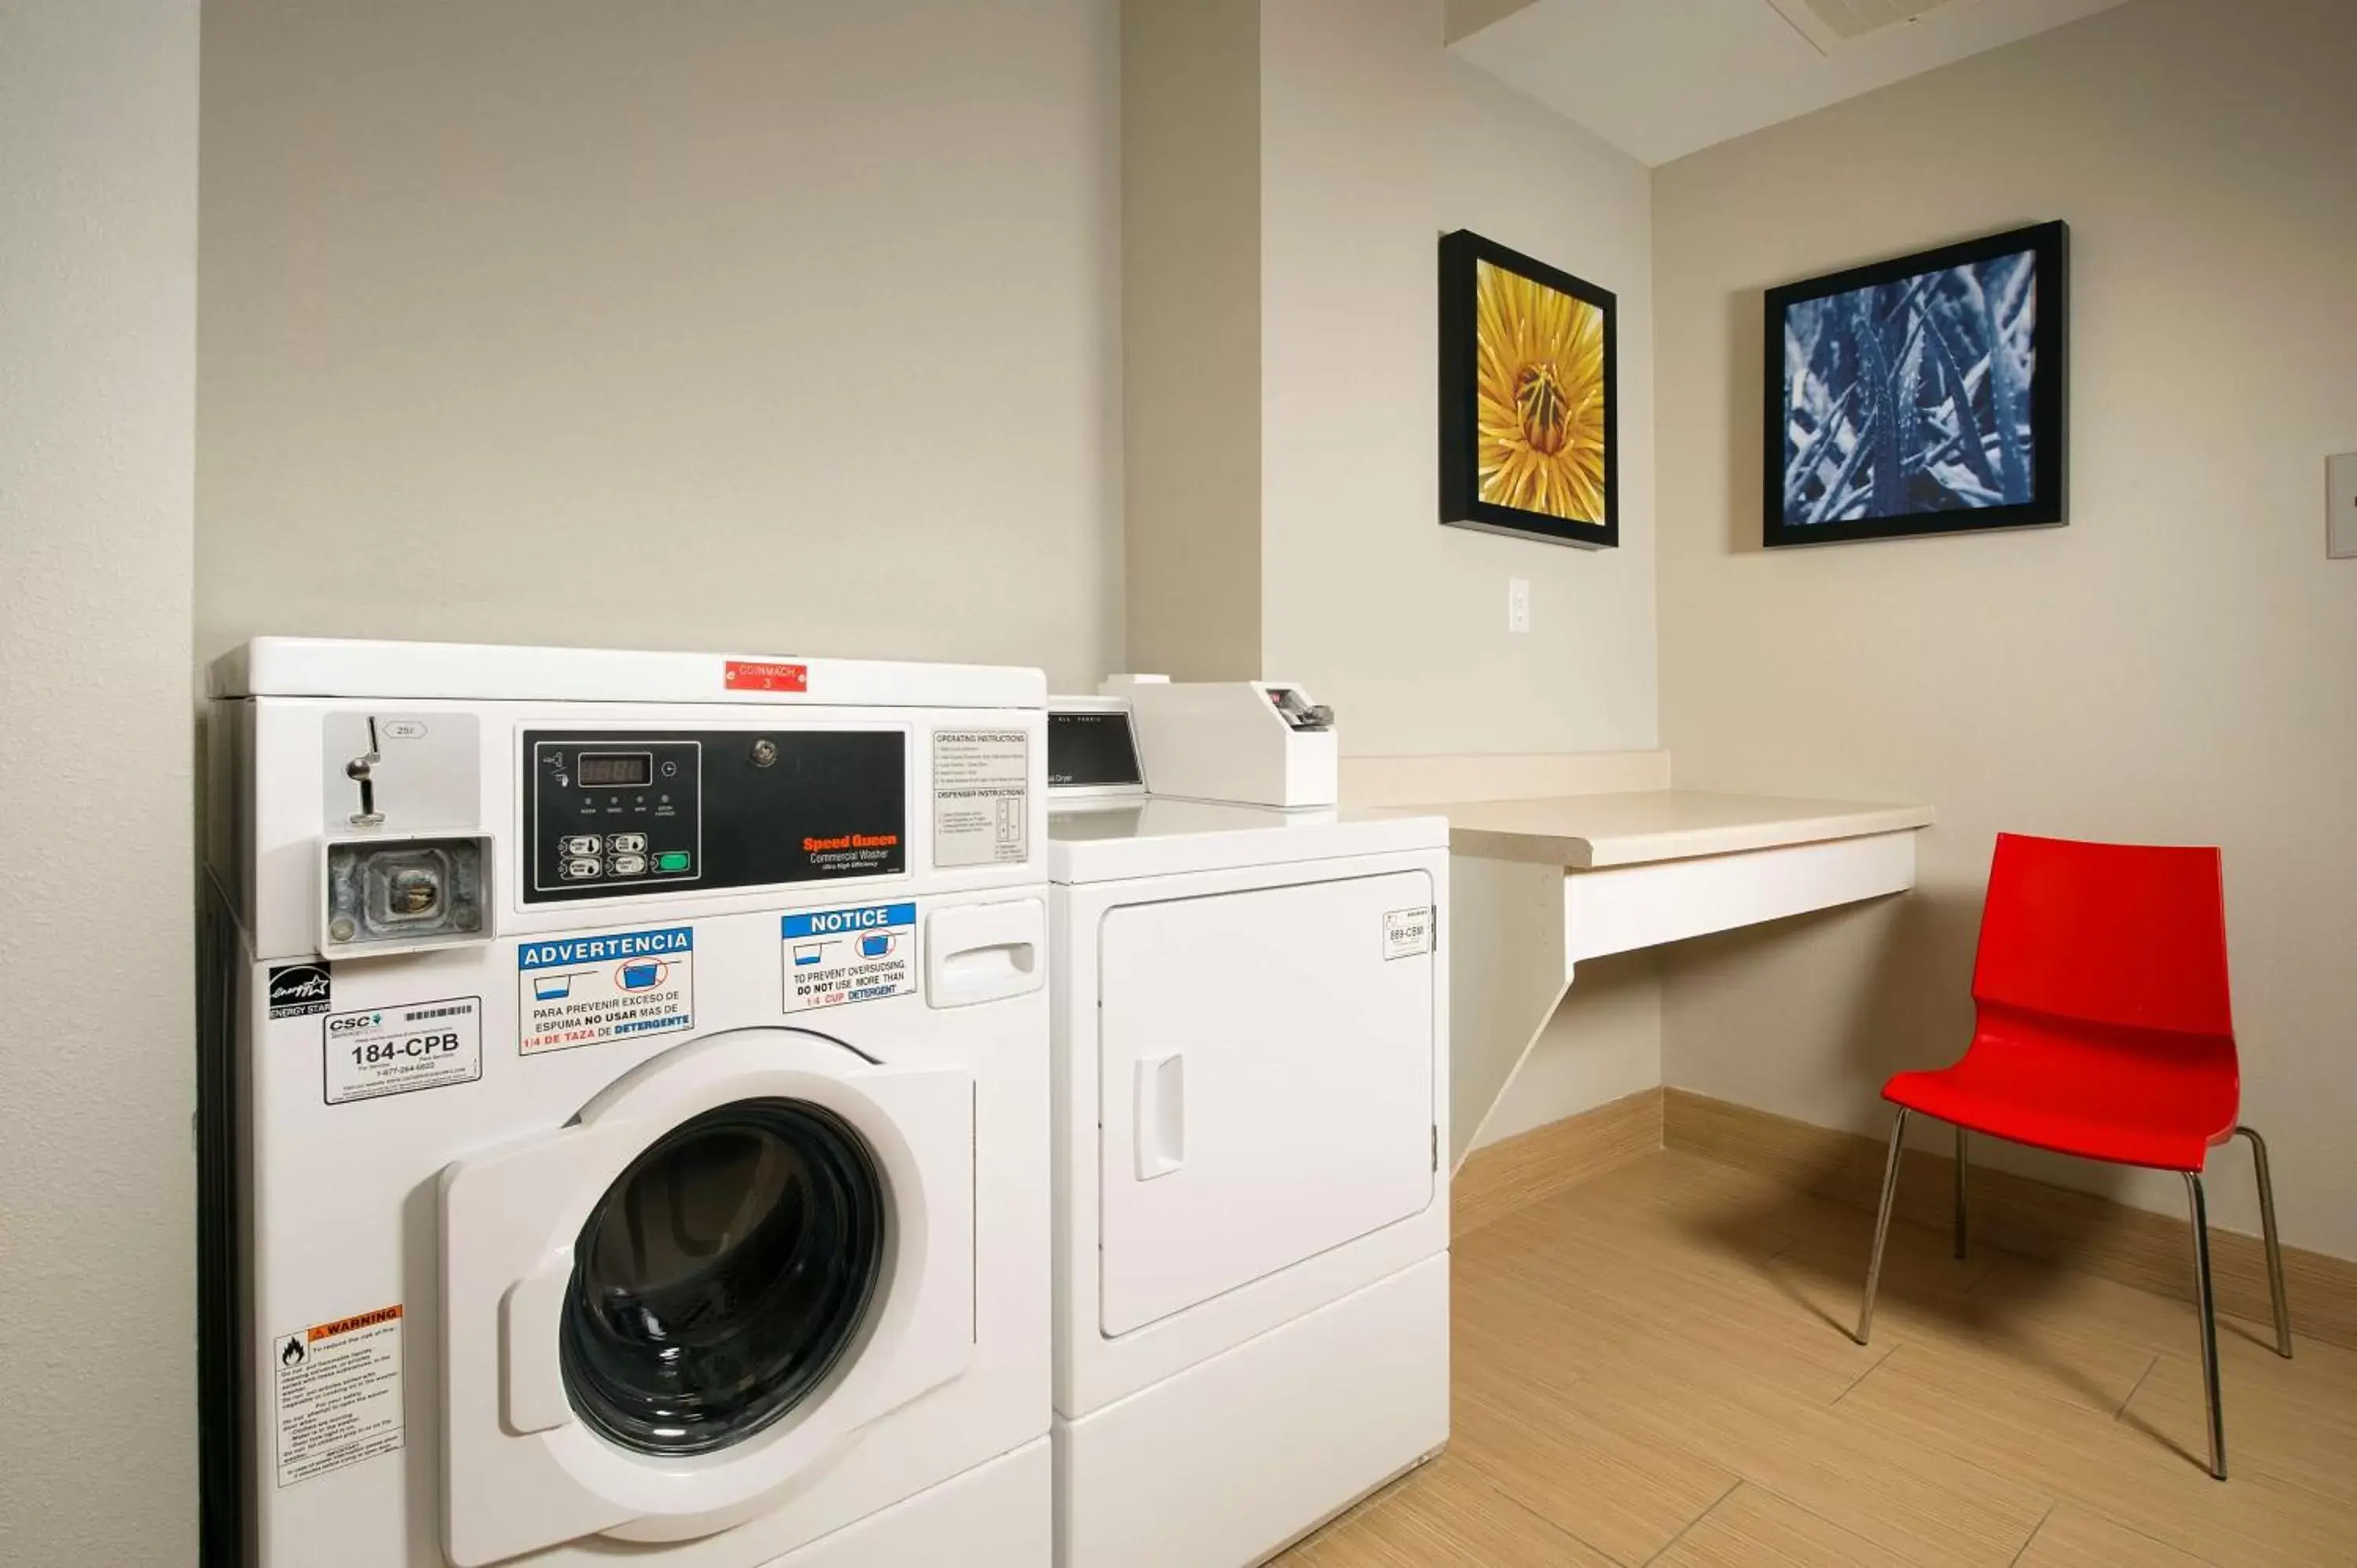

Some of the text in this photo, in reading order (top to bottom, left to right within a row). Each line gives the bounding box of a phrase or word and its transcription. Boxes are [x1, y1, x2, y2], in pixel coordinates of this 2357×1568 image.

[763, 678, 772, 688] 3
[977, 789, 1025, 797] INSTRUCTIONS
[803, 833, 897, 852] Speed Queen
[810, 849, 889, 863] Commercial Washer
[811, 908, 889, 932] NOTICE
[524, 932, 688, 965] ADVERTENCIA
[794, 973, 806, 984] TO
[807, 967, 846, 983] PREVENT
[797, 972, 904, 995] DO NOT USE MORE THAN
[824, 992, 845, 1003] CUP
[848, 984, 897, 1000] DETERGENT
[270, 1006, 306, 1018] ENERGY
[533, 991, 679, 1020] PARA PREVENIR EXCESO DE
[329, 1016, 370, 1031] CSC
[535, 1003, 678, 1033] ESPUMA NO USAR MAS DE
[523, 1014, 690, 1048] 1/4 DE TAZA DE DETERGENTE
[351, 1032, 460, 1064] 184-CPB
[327, 1308, 397, 1334] WARNING
